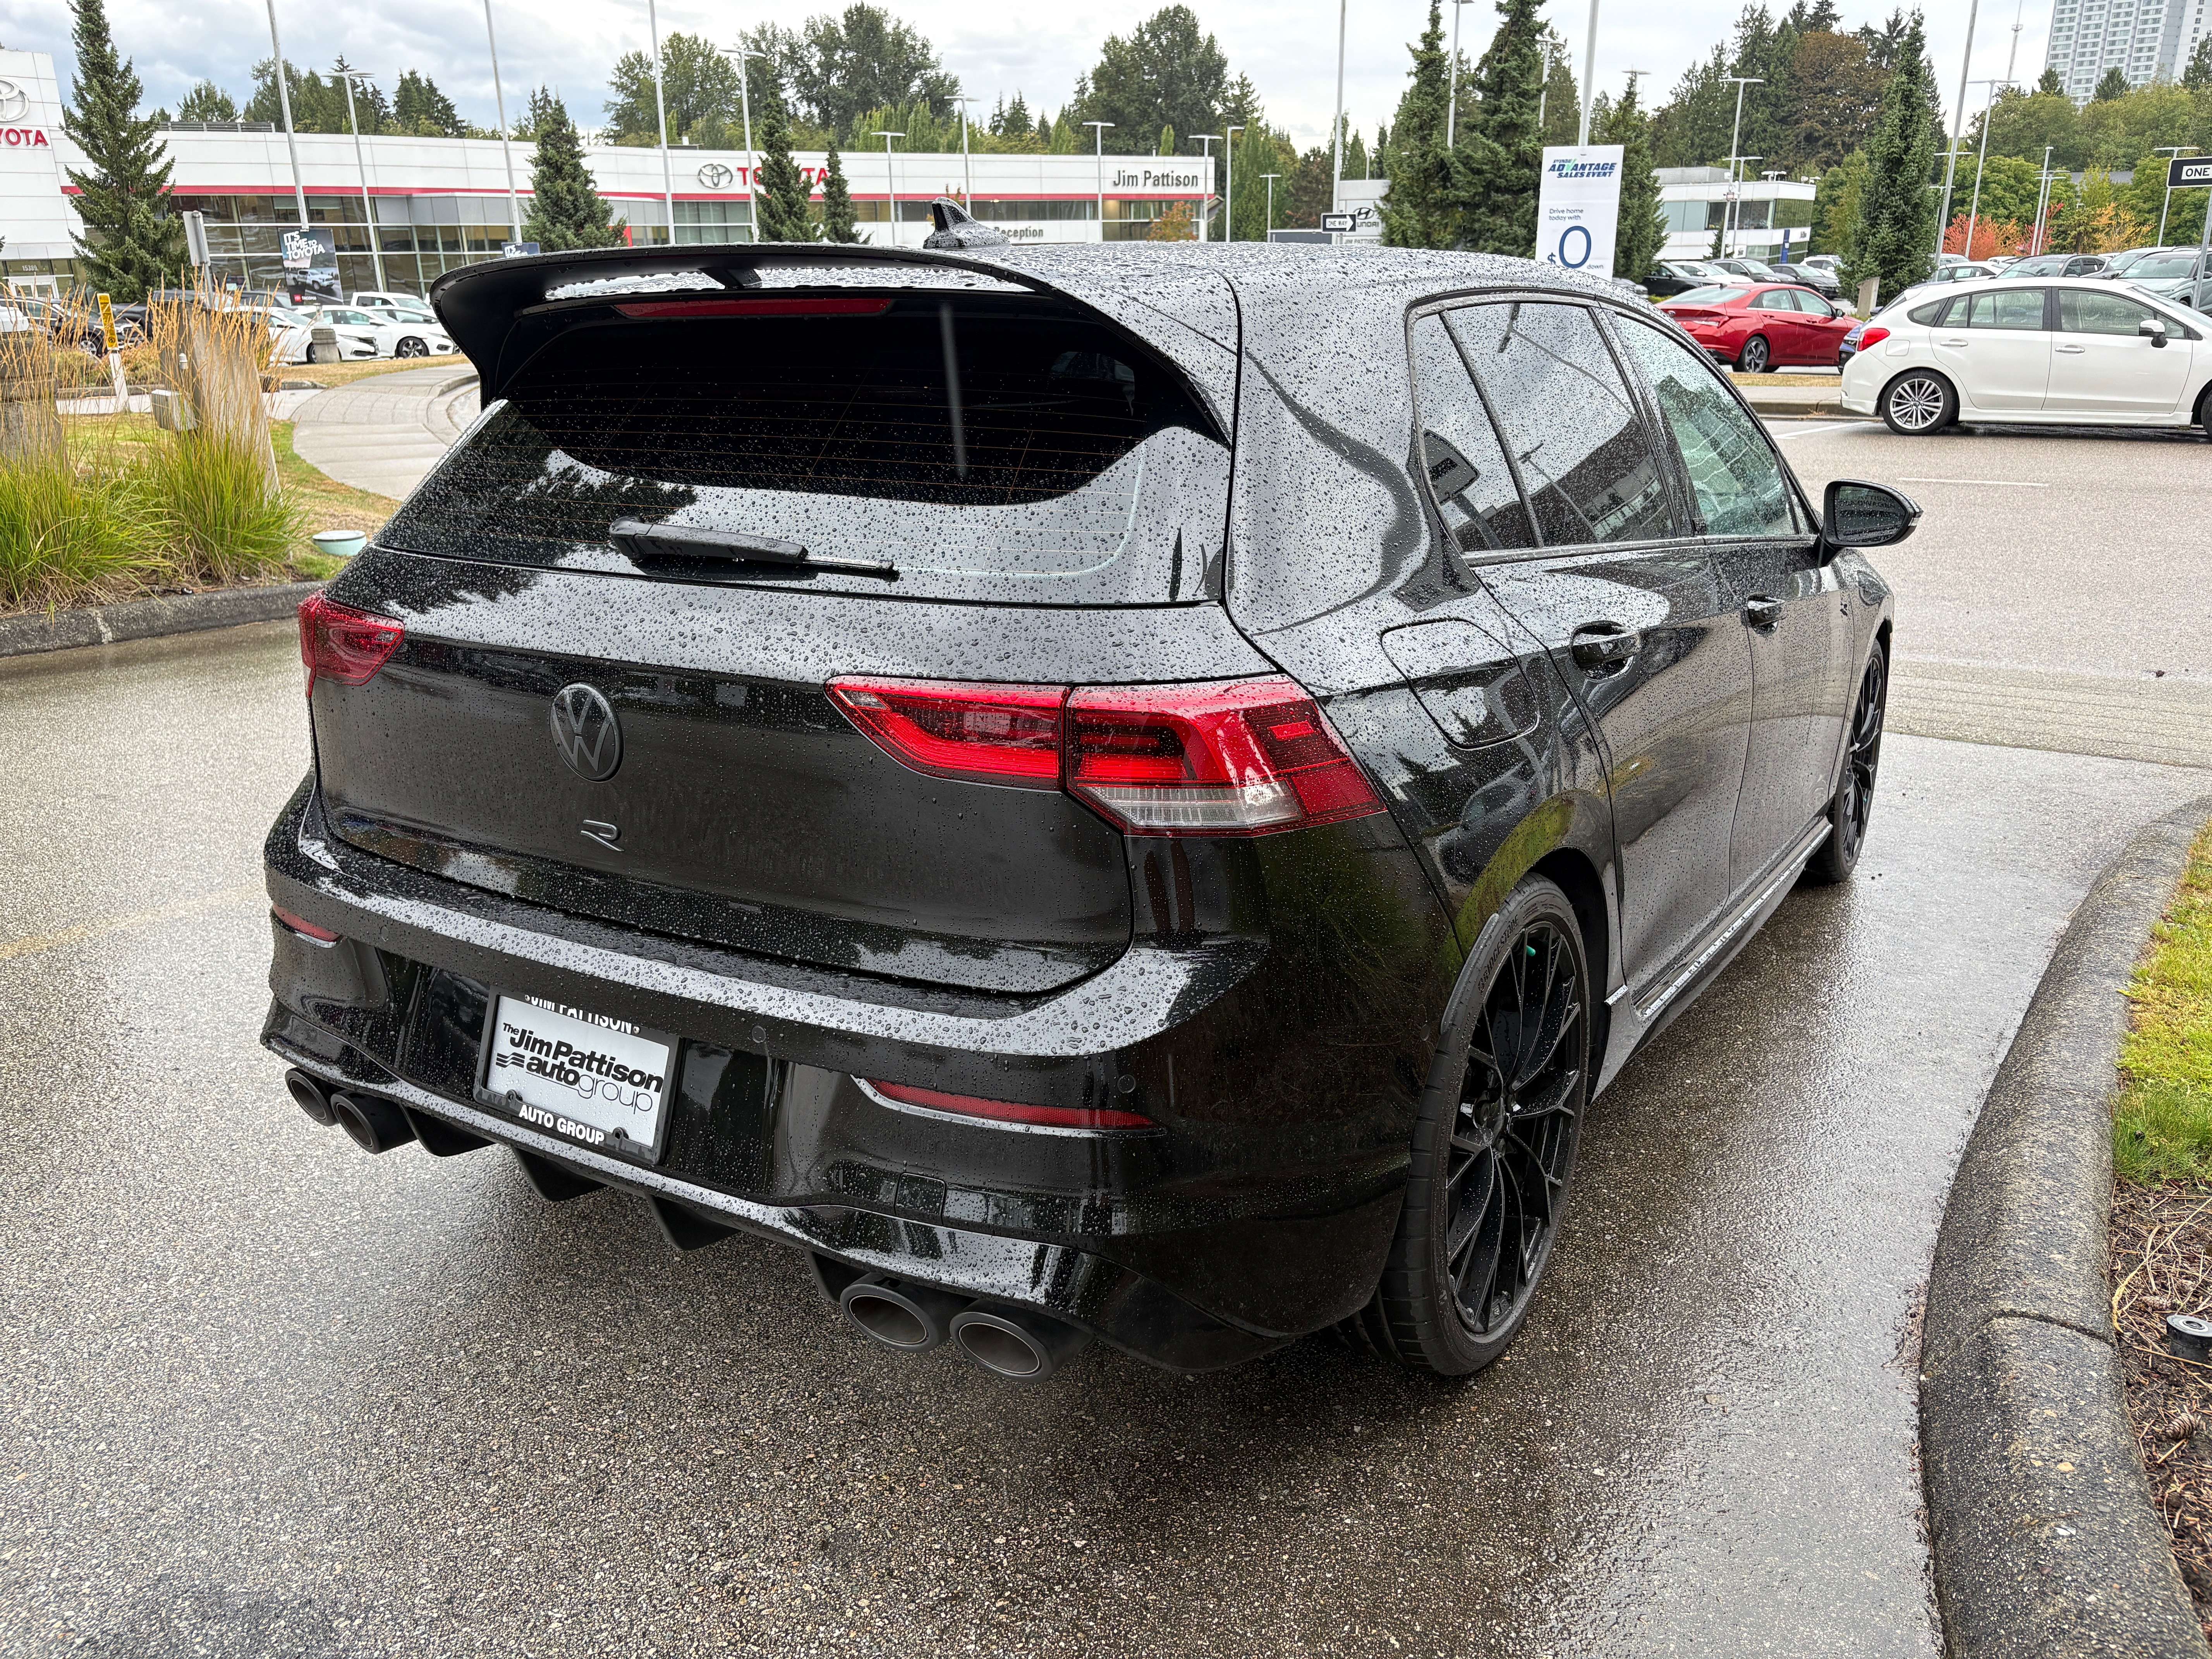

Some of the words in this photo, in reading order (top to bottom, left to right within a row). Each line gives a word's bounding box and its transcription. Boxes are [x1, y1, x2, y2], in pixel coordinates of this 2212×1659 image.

[1113, 170, 1138, 187] Jim
[1143, 170, 1198, 187] Pattison
[2185, 167, 2210, 177] ONE
[285, 238, 308, 251] TIME
[286, 244, 326, 261] TOYOTA
[503, 1022, 520, 1036] The
[519, 1104, 554, 1128] AUTO
[556, 1119, 605, 1145] GROUP
